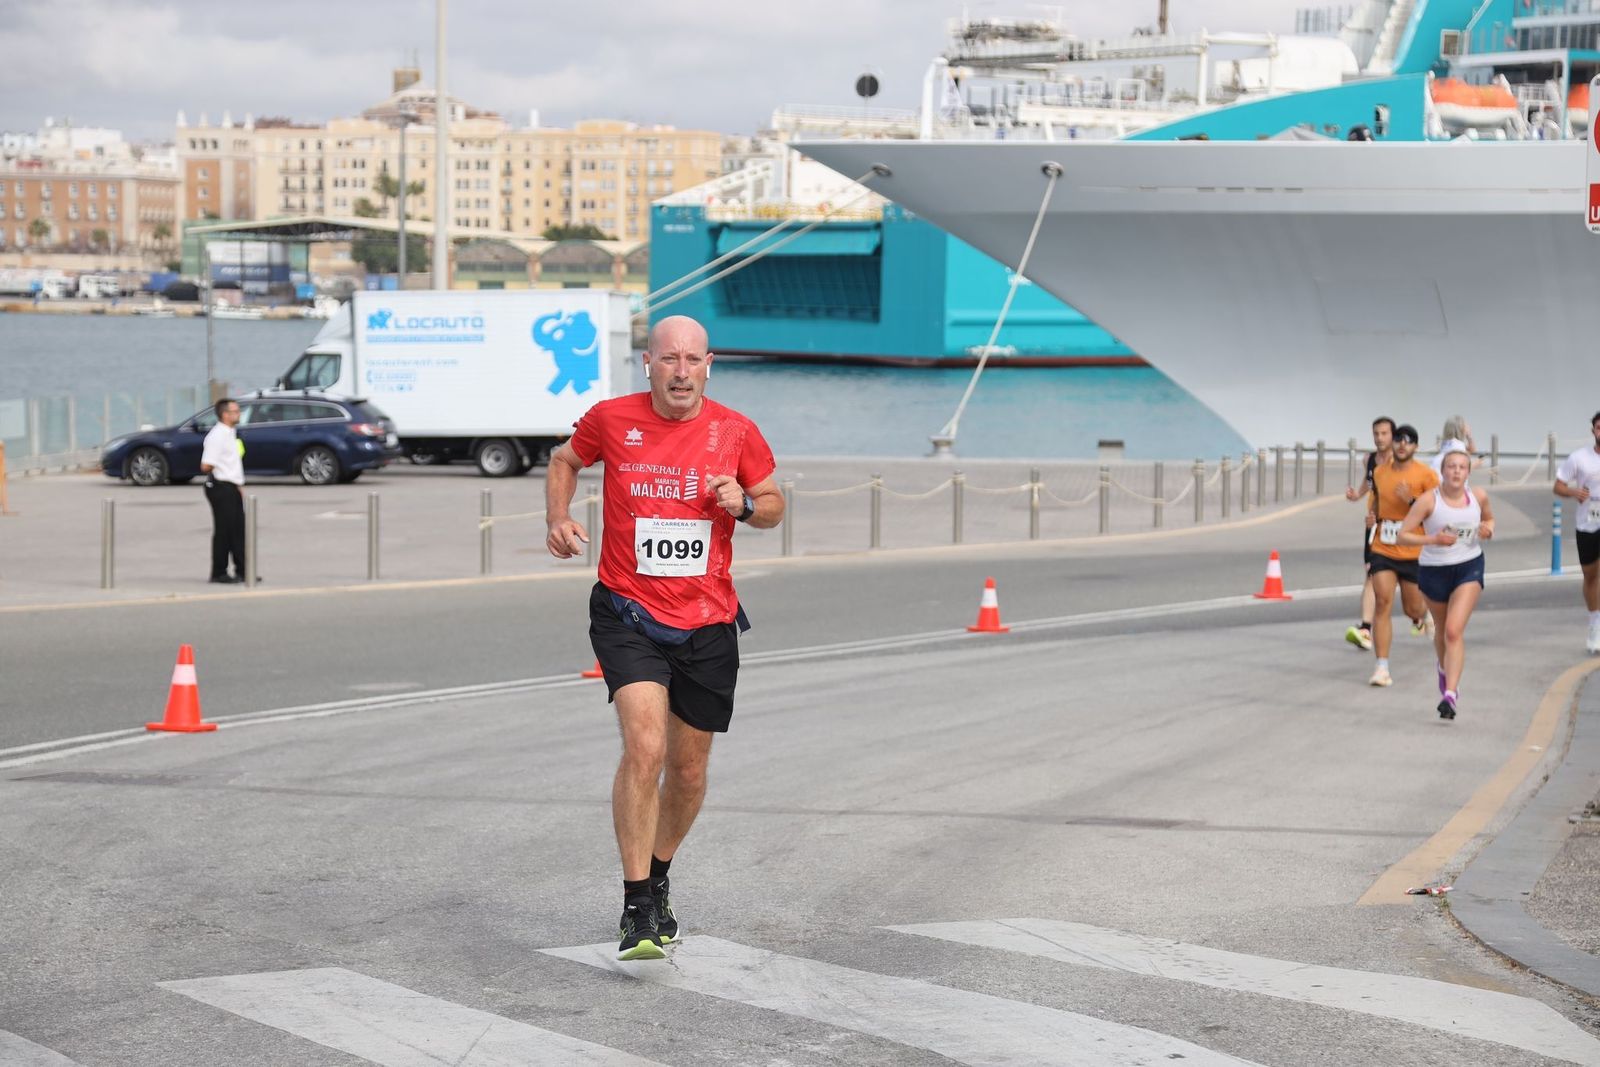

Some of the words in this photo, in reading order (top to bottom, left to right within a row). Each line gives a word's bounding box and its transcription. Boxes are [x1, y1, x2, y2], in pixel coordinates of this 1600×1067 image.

[394, 316, 484, 329] LOCAUTO
[631, 463, 681, 475] GENERALI
[630, 481, 681, 500] MÁLAGA
[641, 538, 704, 560] 1099
